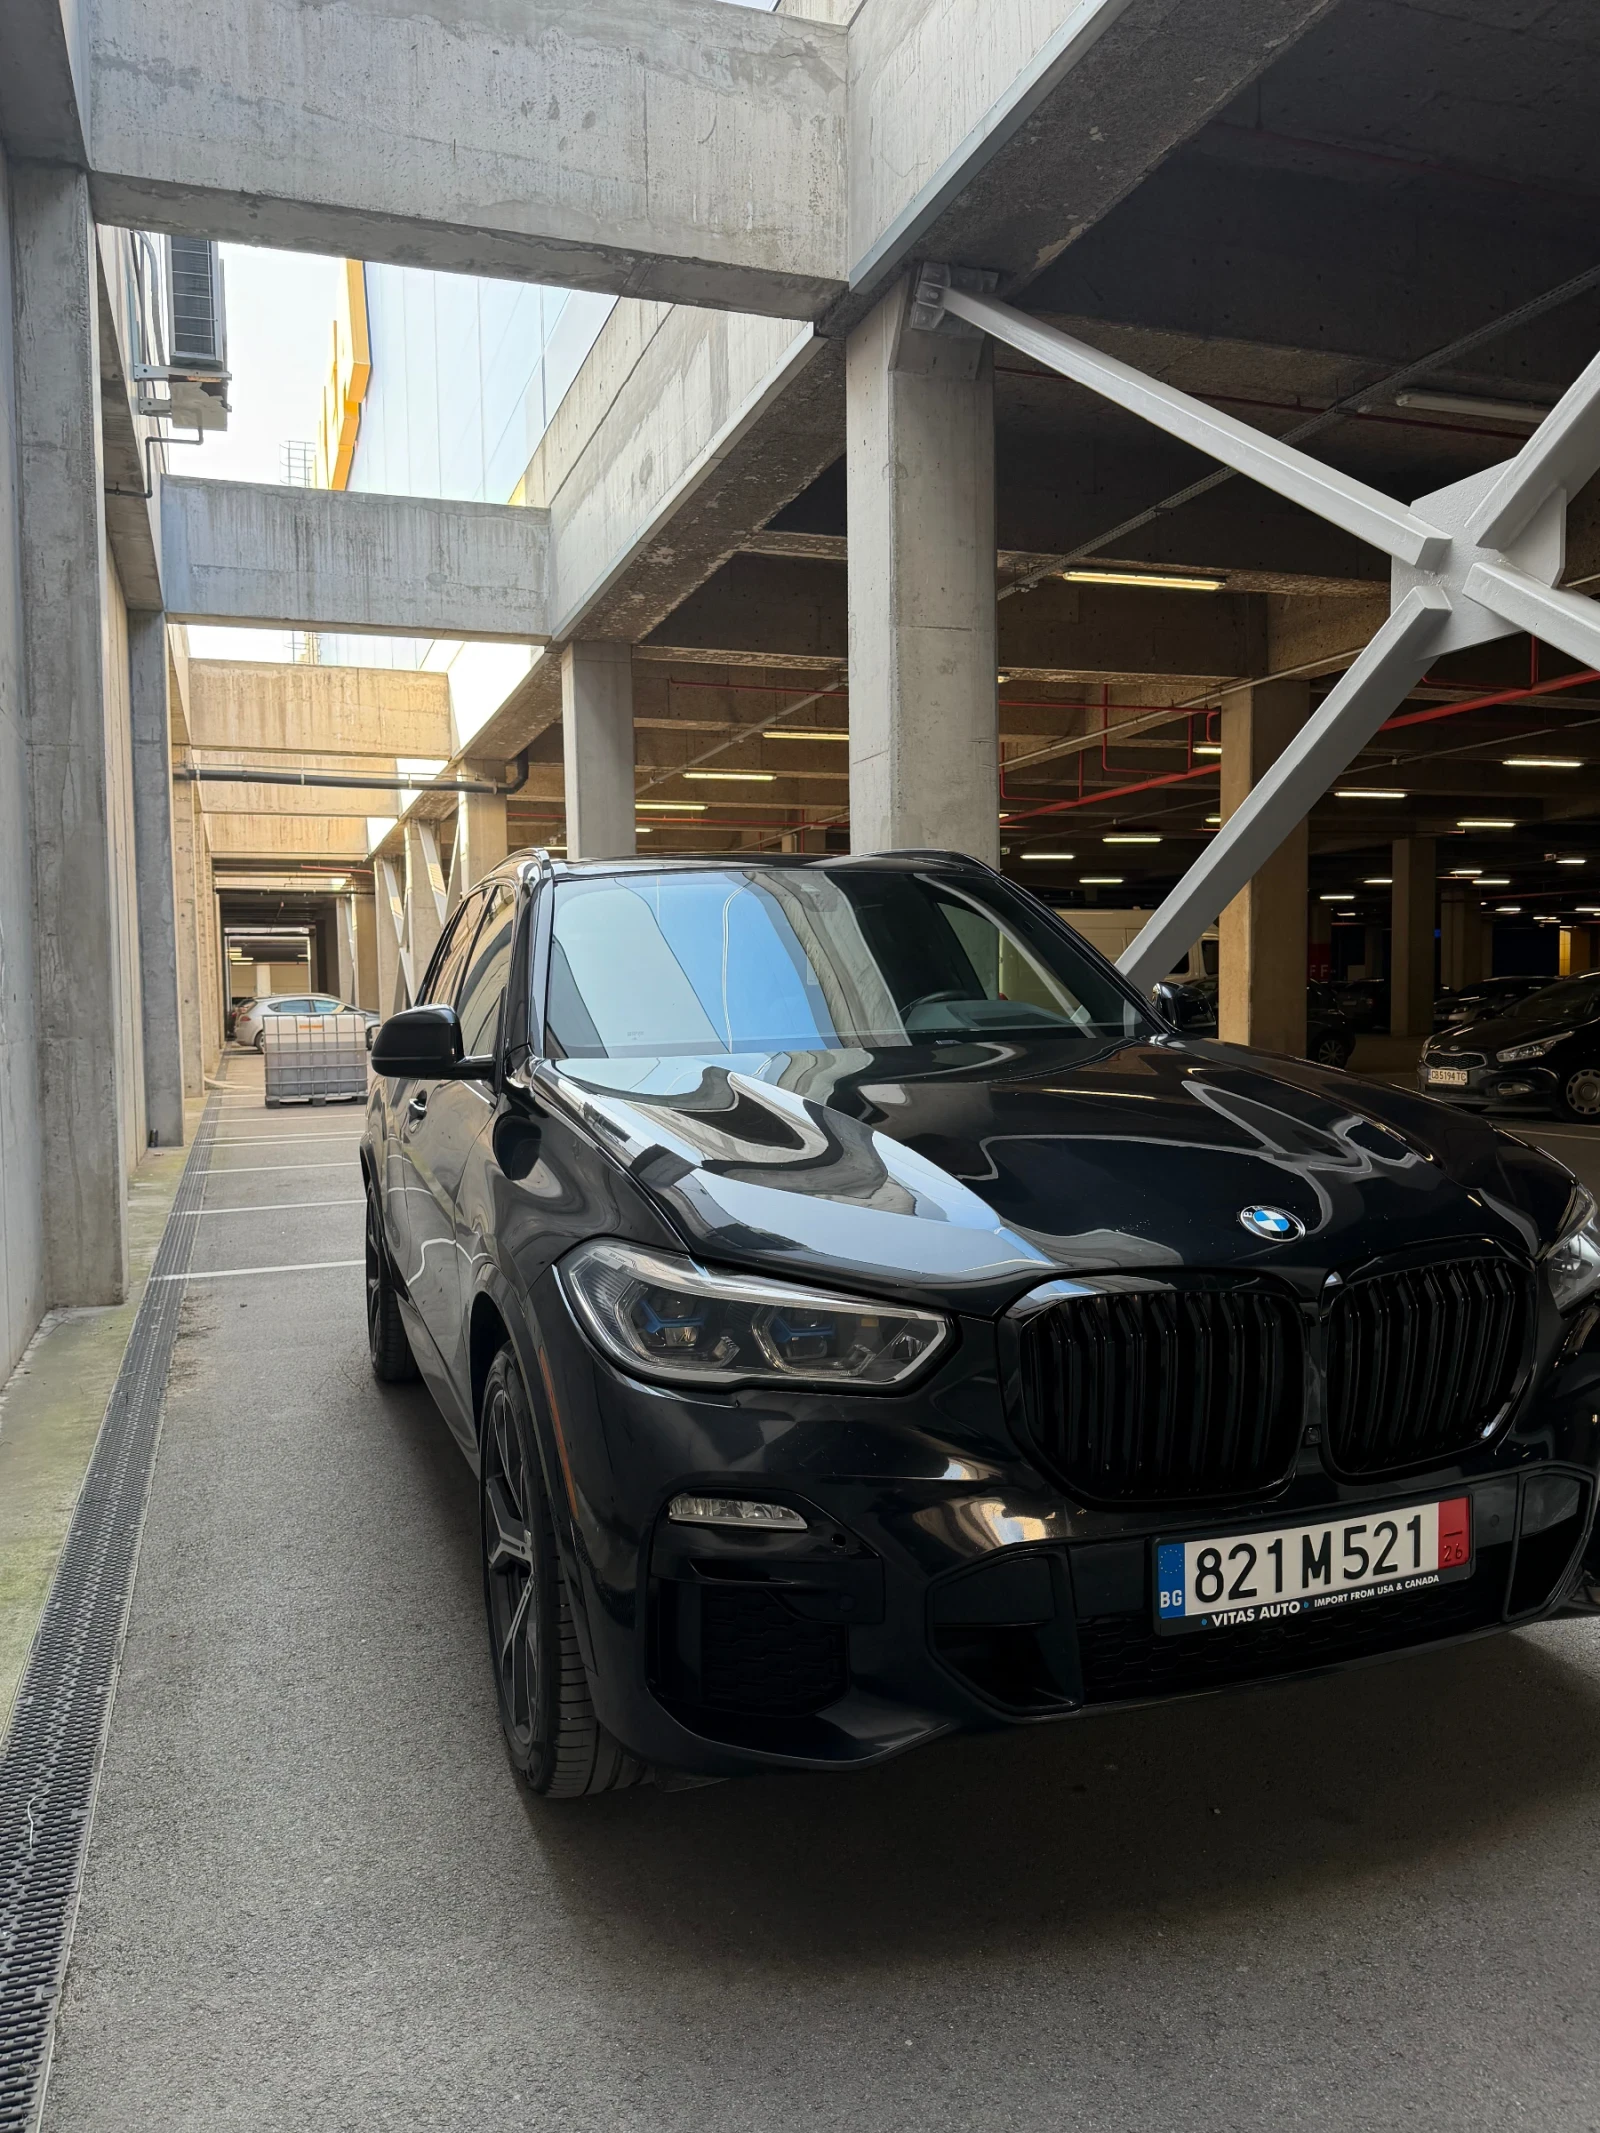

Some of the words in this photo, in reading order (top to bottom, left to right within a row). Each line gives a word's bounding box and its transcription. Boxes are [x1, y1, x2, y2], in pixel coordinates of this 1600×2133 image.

[1195, 1515, 1421, 1603] 821M521
[1443, 1543, 1463, 1562] 26
[1160, 1589, 1183, 1608] BG
[1211, 1608, 1255, 1627] VITAS
[1259, 1601, 1301, 1620] AUTO
[1314, 1593, 1348, 1608] IMPORT
[1350, 1588, 1375, 1601] FROM
[1377, 1584, 1395, 1595] USA
[1396, 1582, 1403, 1591] &
[1405, 1574, 1440, 1589] CANADA
